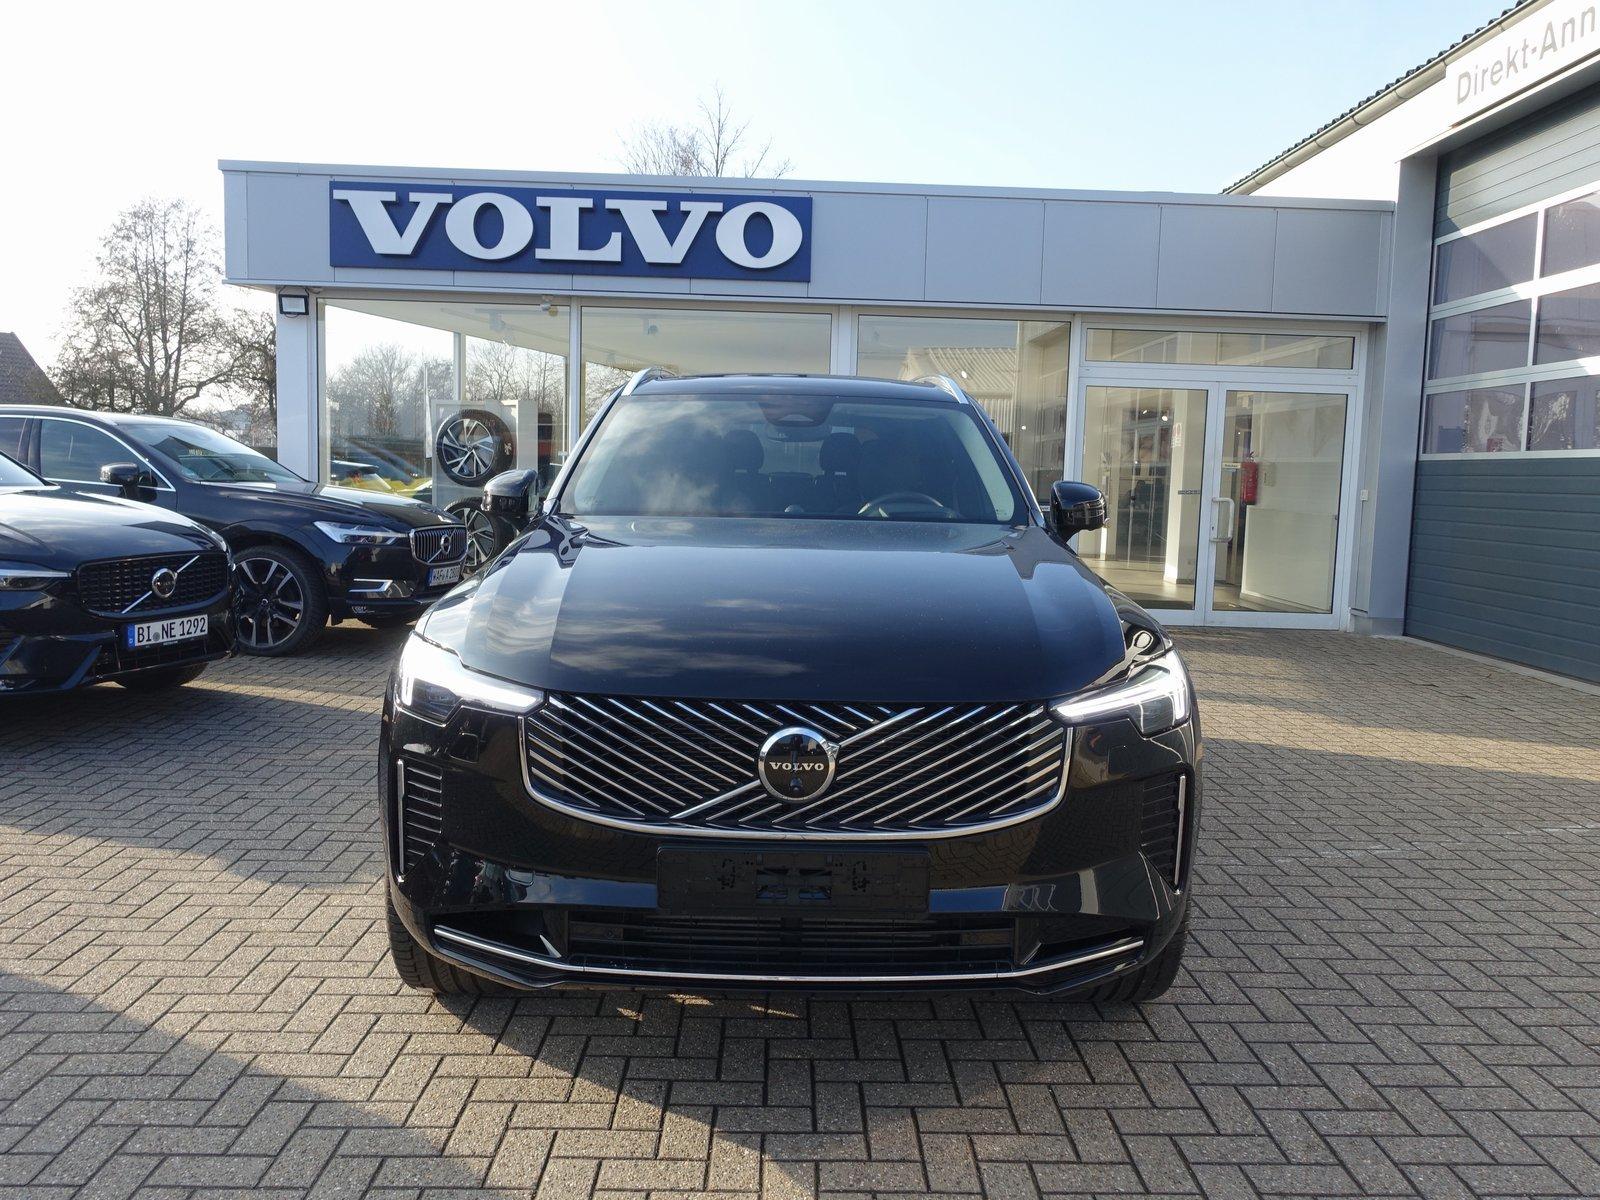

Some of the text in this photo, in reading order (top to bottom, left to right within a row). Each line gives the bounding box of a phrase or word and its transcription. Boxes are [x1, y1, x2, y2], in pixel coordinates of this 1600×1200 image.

[333, 189, 803, 269] VOLVO
[137, 617, 205, 643] BI NE 1292
[769, 762, 824, 771] VOLVO
